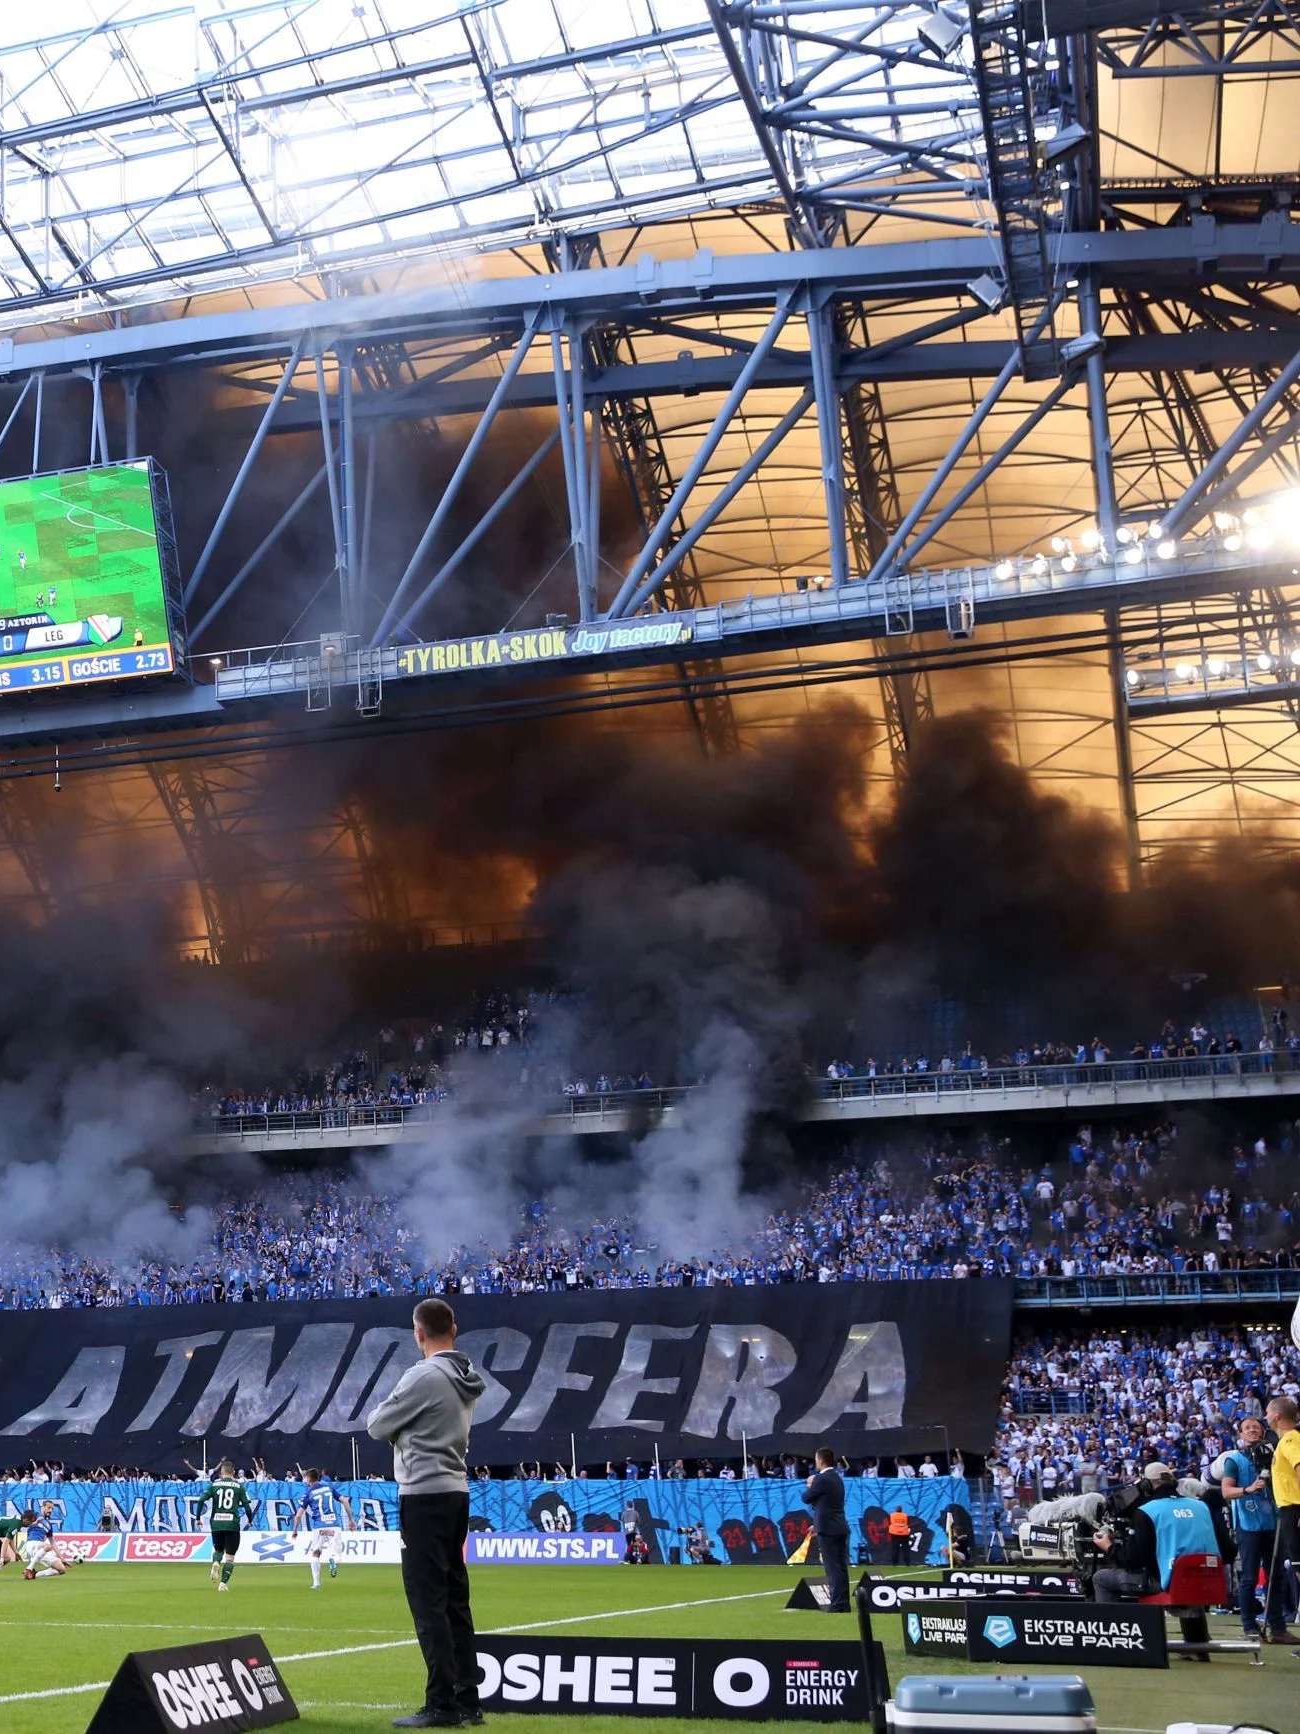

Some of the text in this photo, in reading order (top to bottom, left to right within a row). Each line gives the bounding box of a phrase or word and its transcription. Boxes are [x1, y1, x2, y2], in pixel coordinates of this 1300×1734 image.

[7, 614, 48, 628] AZTORIN
[45, 630, 64, 642] LEG
[572, 629, 609, 654] Joy
[31, 666, 61, 682] 3.15
[72, 652, 165, 677] GOŚCIE 2.73
[216, 1487, 235, 1510] 18
[312, 1491, 334, 1516] 77
[1172, 1507, 1194, 1519] 063
[56, 1539, 94, 1556] esa
[132, 1537, 188, 1557] tesa
[475, 1538, 619, 1559] WWW.STS.PL
[921, 1616, 967, 1631] EKSTRAKLASA
[1023, 1618, 1143, 1637] EKSTRAKLASA
[923, 1630, 943, 1642] LIVE
[1024, 1634, 1146, 1650] LIVE PARK
[712, 1657, 771, 1707] O
[785, 1669, 859, 1688] ENERGY
[152, 1662, 244, 1729] OSHEE
[785, 1688, 845, 1706] DRINK
